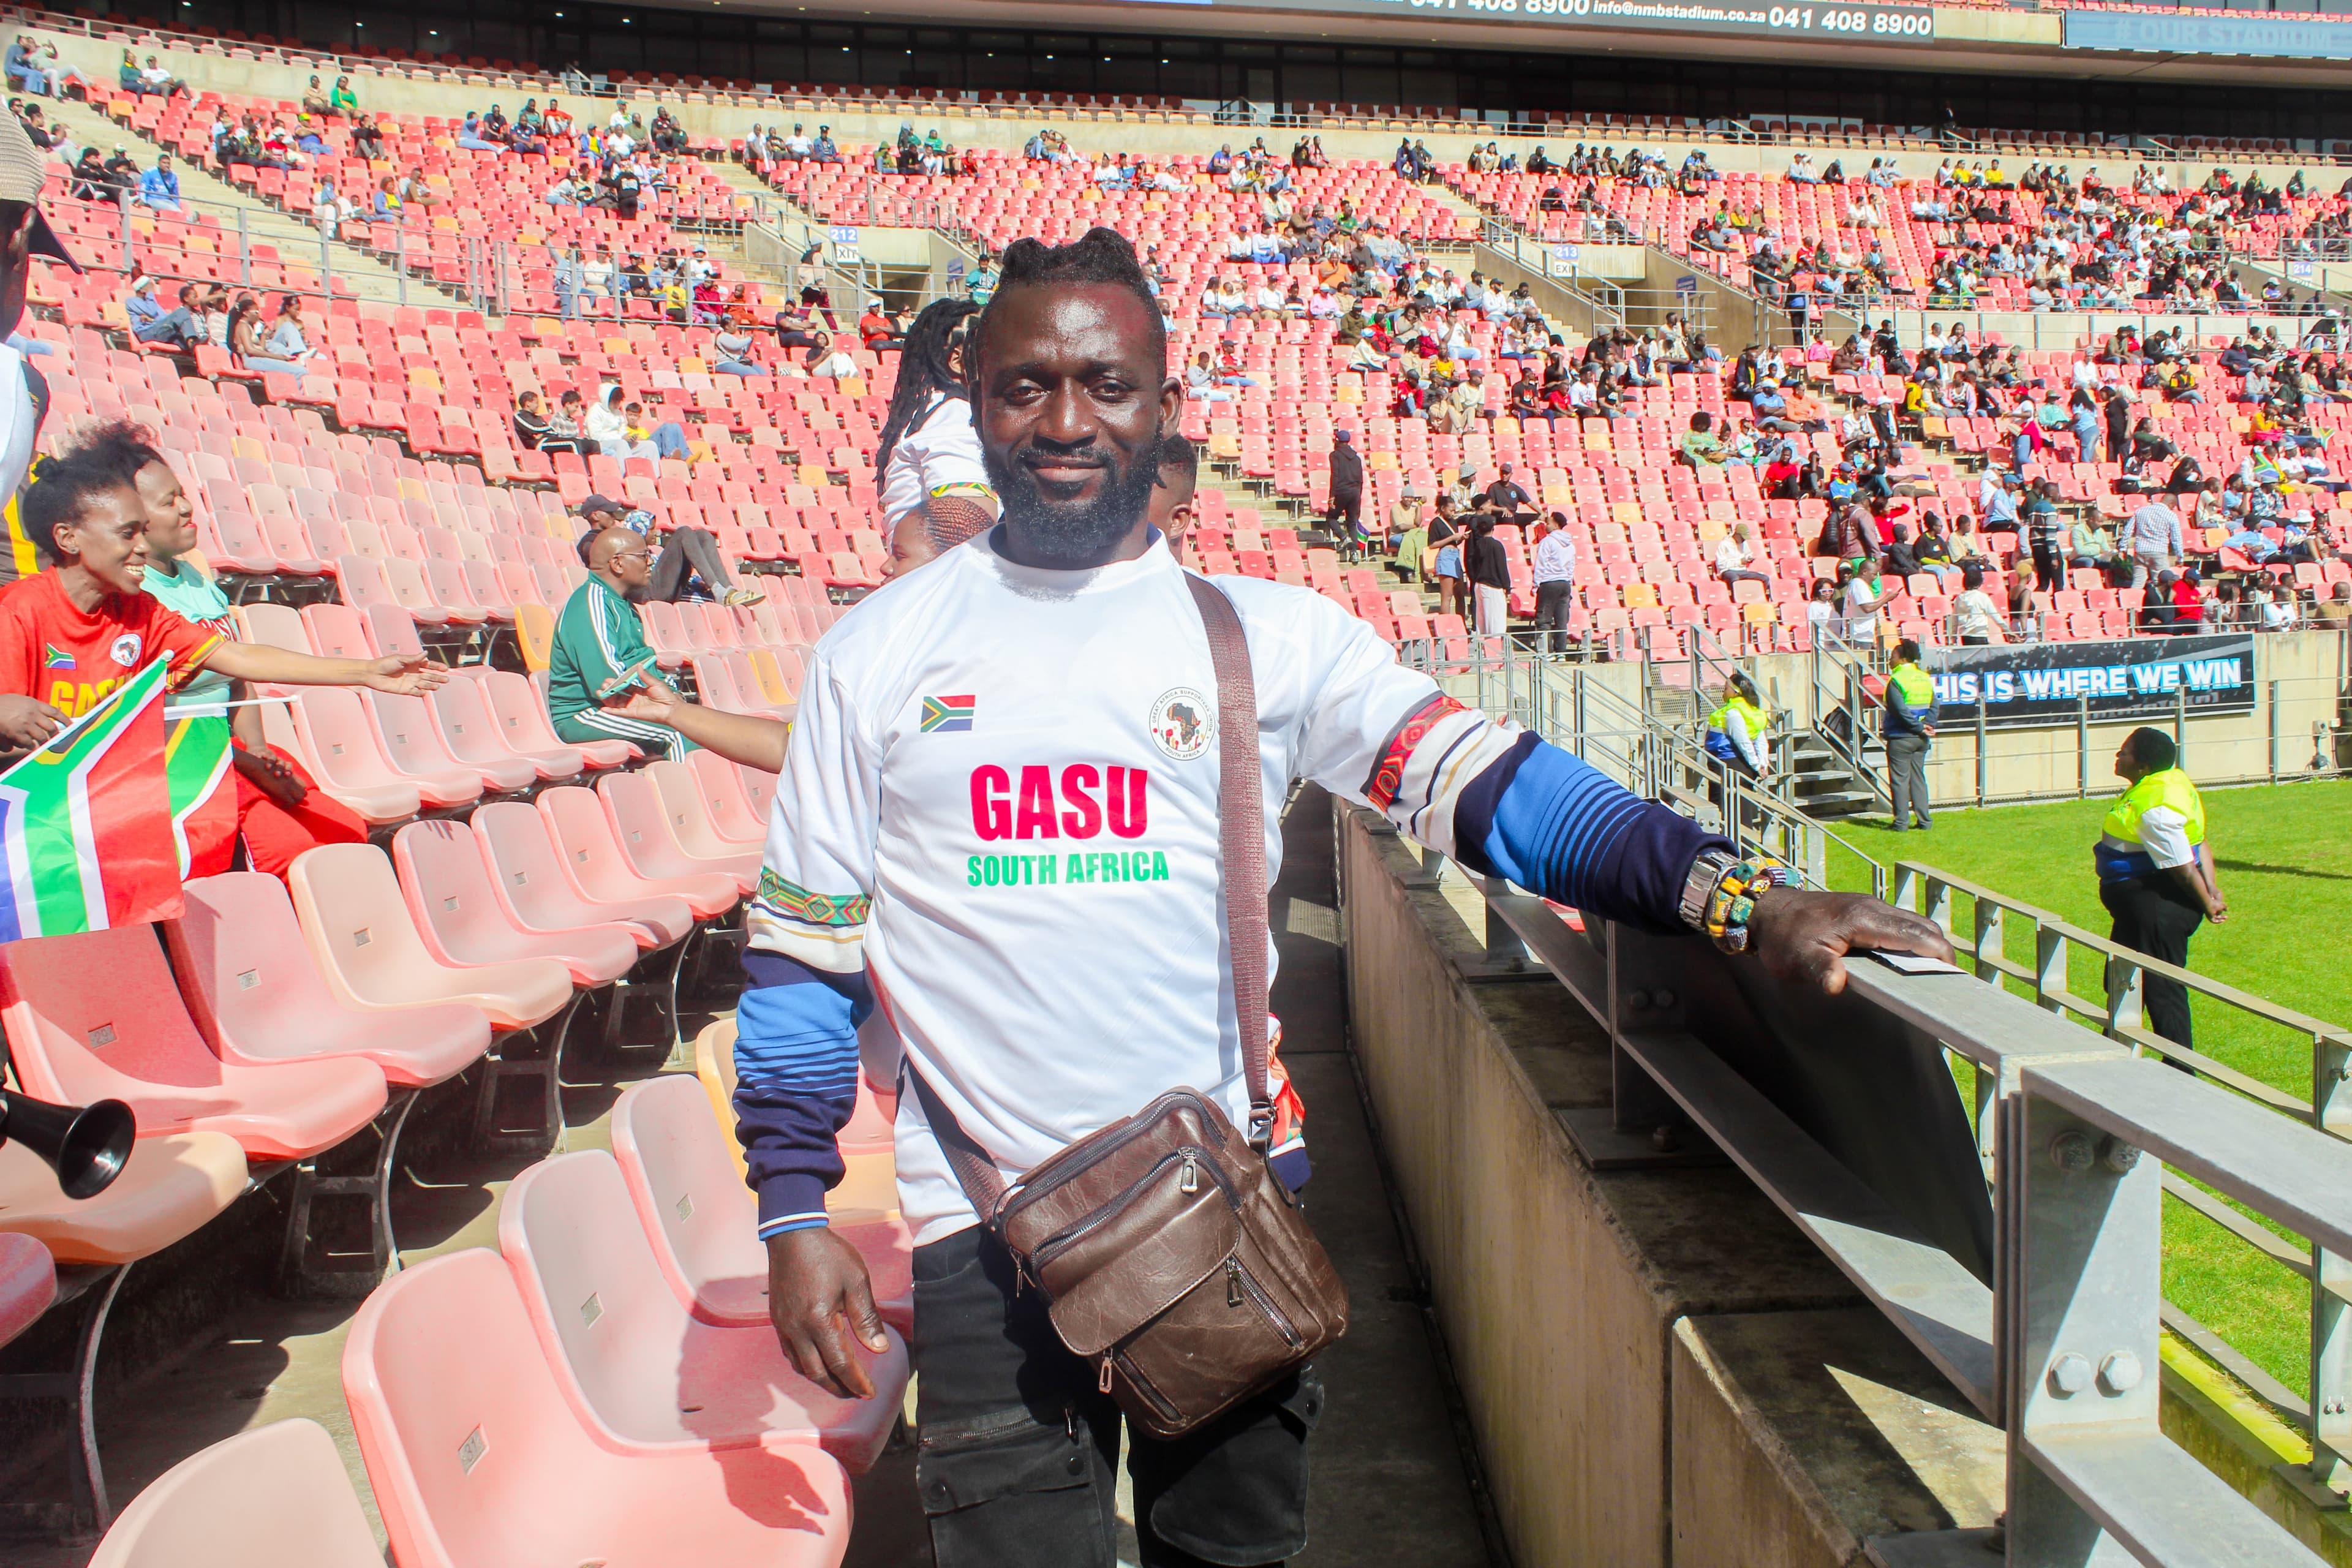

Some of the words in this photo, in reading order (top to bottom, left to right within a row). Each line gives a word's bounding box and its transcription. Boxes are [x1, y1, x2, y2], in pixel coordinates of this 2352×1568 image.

[1593, 0, 1766, 23] info@nmbstadium.co.za
[1768, 6, 1812, 29] 041
[1821, 9, 1866, 32] 408
[1872, 12, 1932, 37] 8900
[2139, 21, 2199, 43] OUR
[831, 228, 856, 241] 212
[837, 249, 858, 258] XIT
[1556, 246, 1577, 257] 213
[1556, 265, 1572, 273] EXI
[2293, 264, 2312, 274] 214
[1931, 673, 1979, 704] HIS
[1985, 671, 2015, 703] IS
[2019, 665, 2128, 701] WHERE
[2130, 662, 2180, 695] WE
[2183, 658, 2242, 691] WIN
[1152, 705, 1160, 723] GREAT
[1159, 691, 1178, 704] AFRICA
[1165, 747, 1182, 758] SOUTH
[1182, 750, 1200, 758] AFRICA
[970, 763, 1148, 841] GASU
[967, 854, 1057, 887] SOUTH
[1065, 850, 1169, 883] AFRICA
